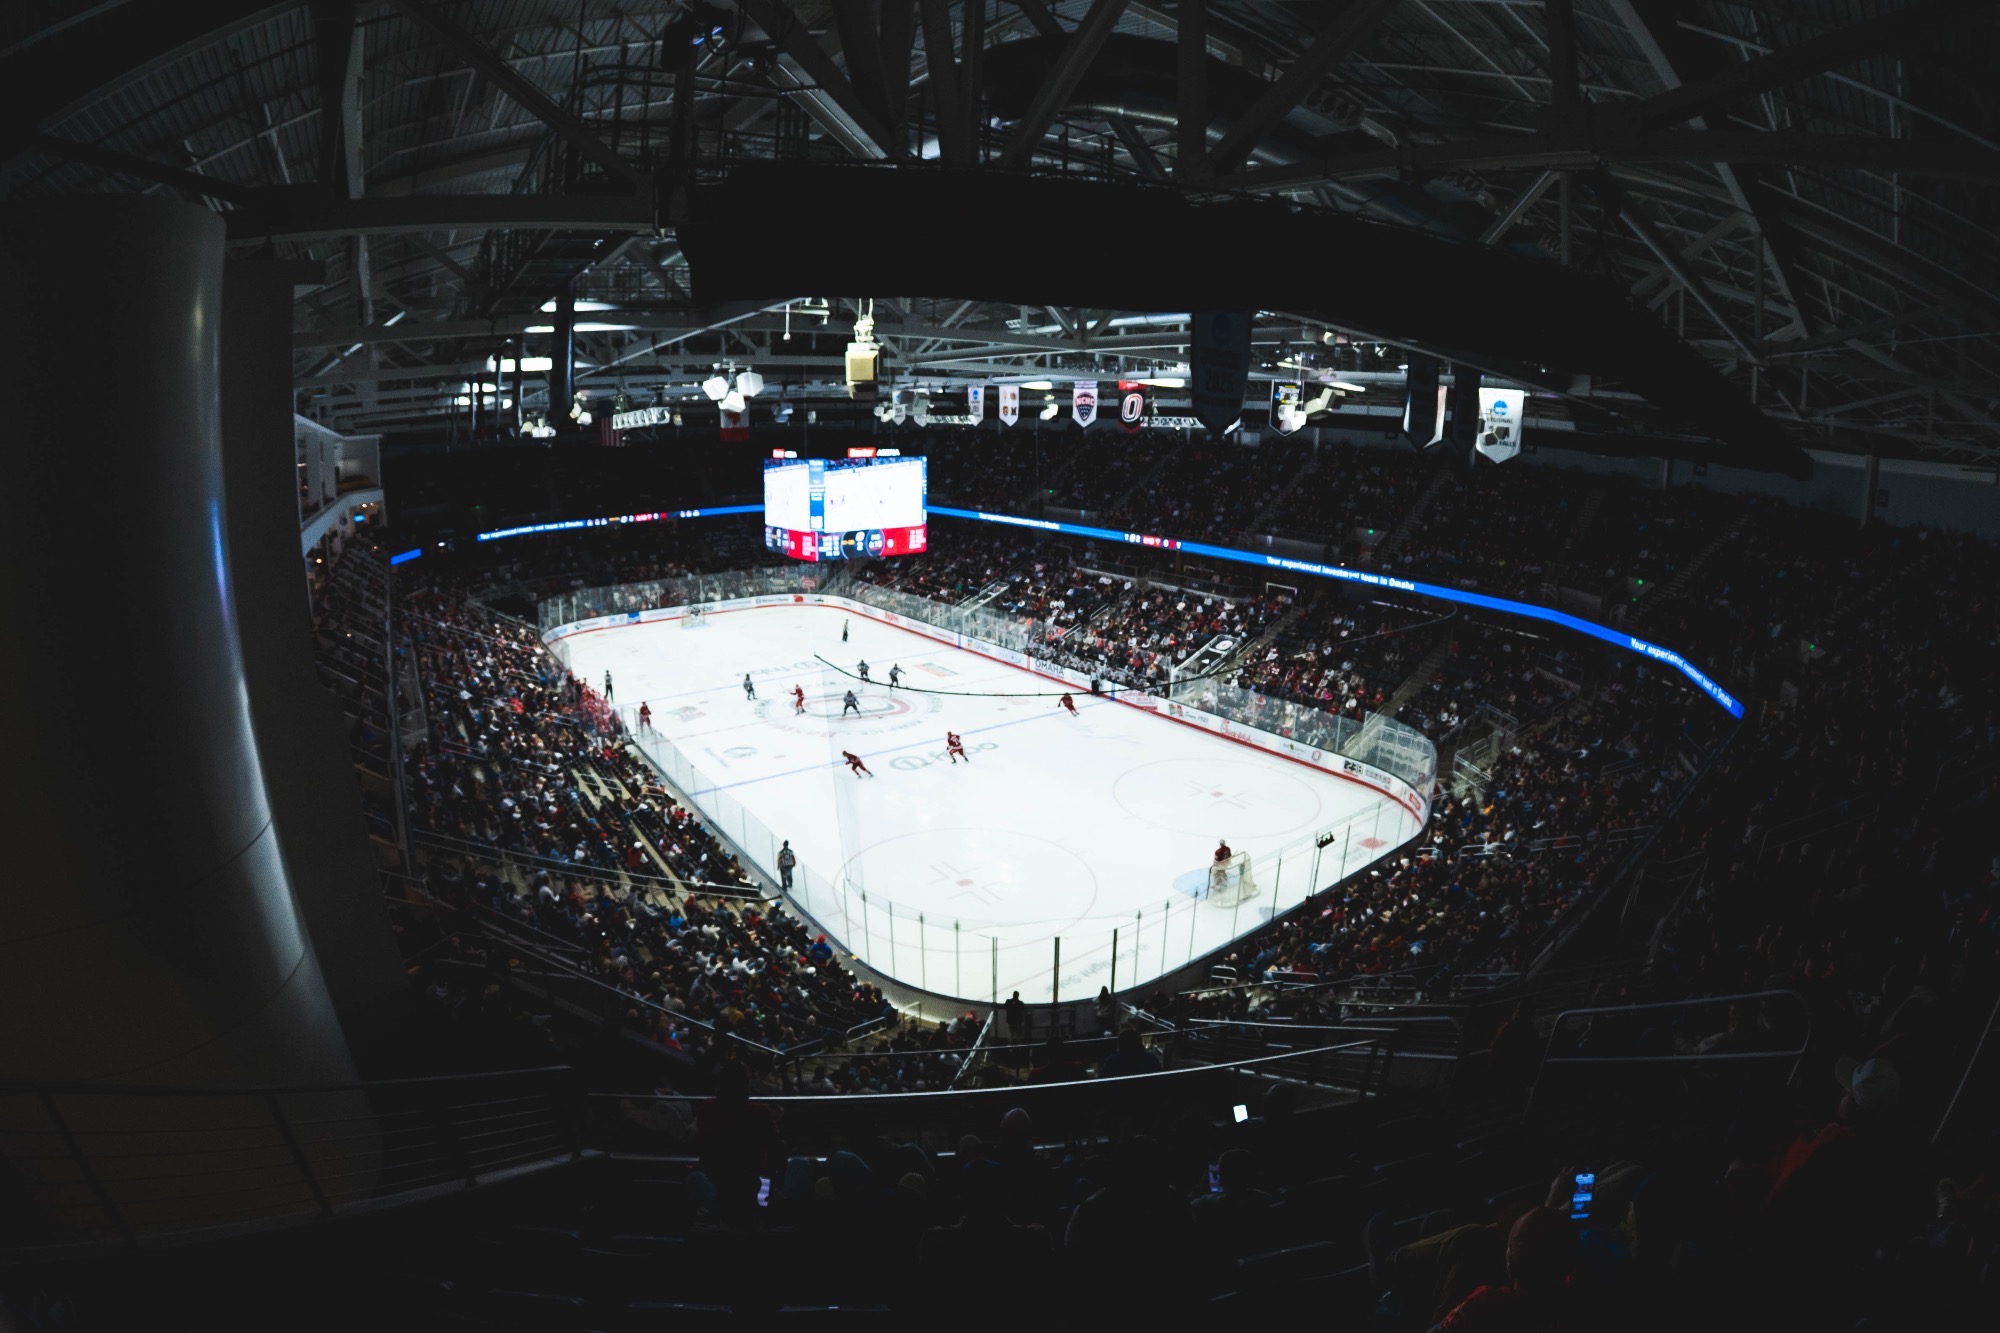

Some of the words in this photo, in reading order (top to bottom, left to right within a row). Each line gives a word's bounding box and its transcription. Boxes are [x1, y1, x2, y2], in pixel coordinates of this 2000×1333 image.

[1076, 396, 1095, 407] NCHC
[1266, 556, 1281, 566] Your
[1282, 560, 1321, 573] experienced
[1322, 565, 1359, 579] investment
[1361, 573, 1378, 584] team
[1389, 577, 1415, 590] Omaha
[1631, 638, 1646, 651] Your
[1035, 659, 1064, 675] OMAHA
